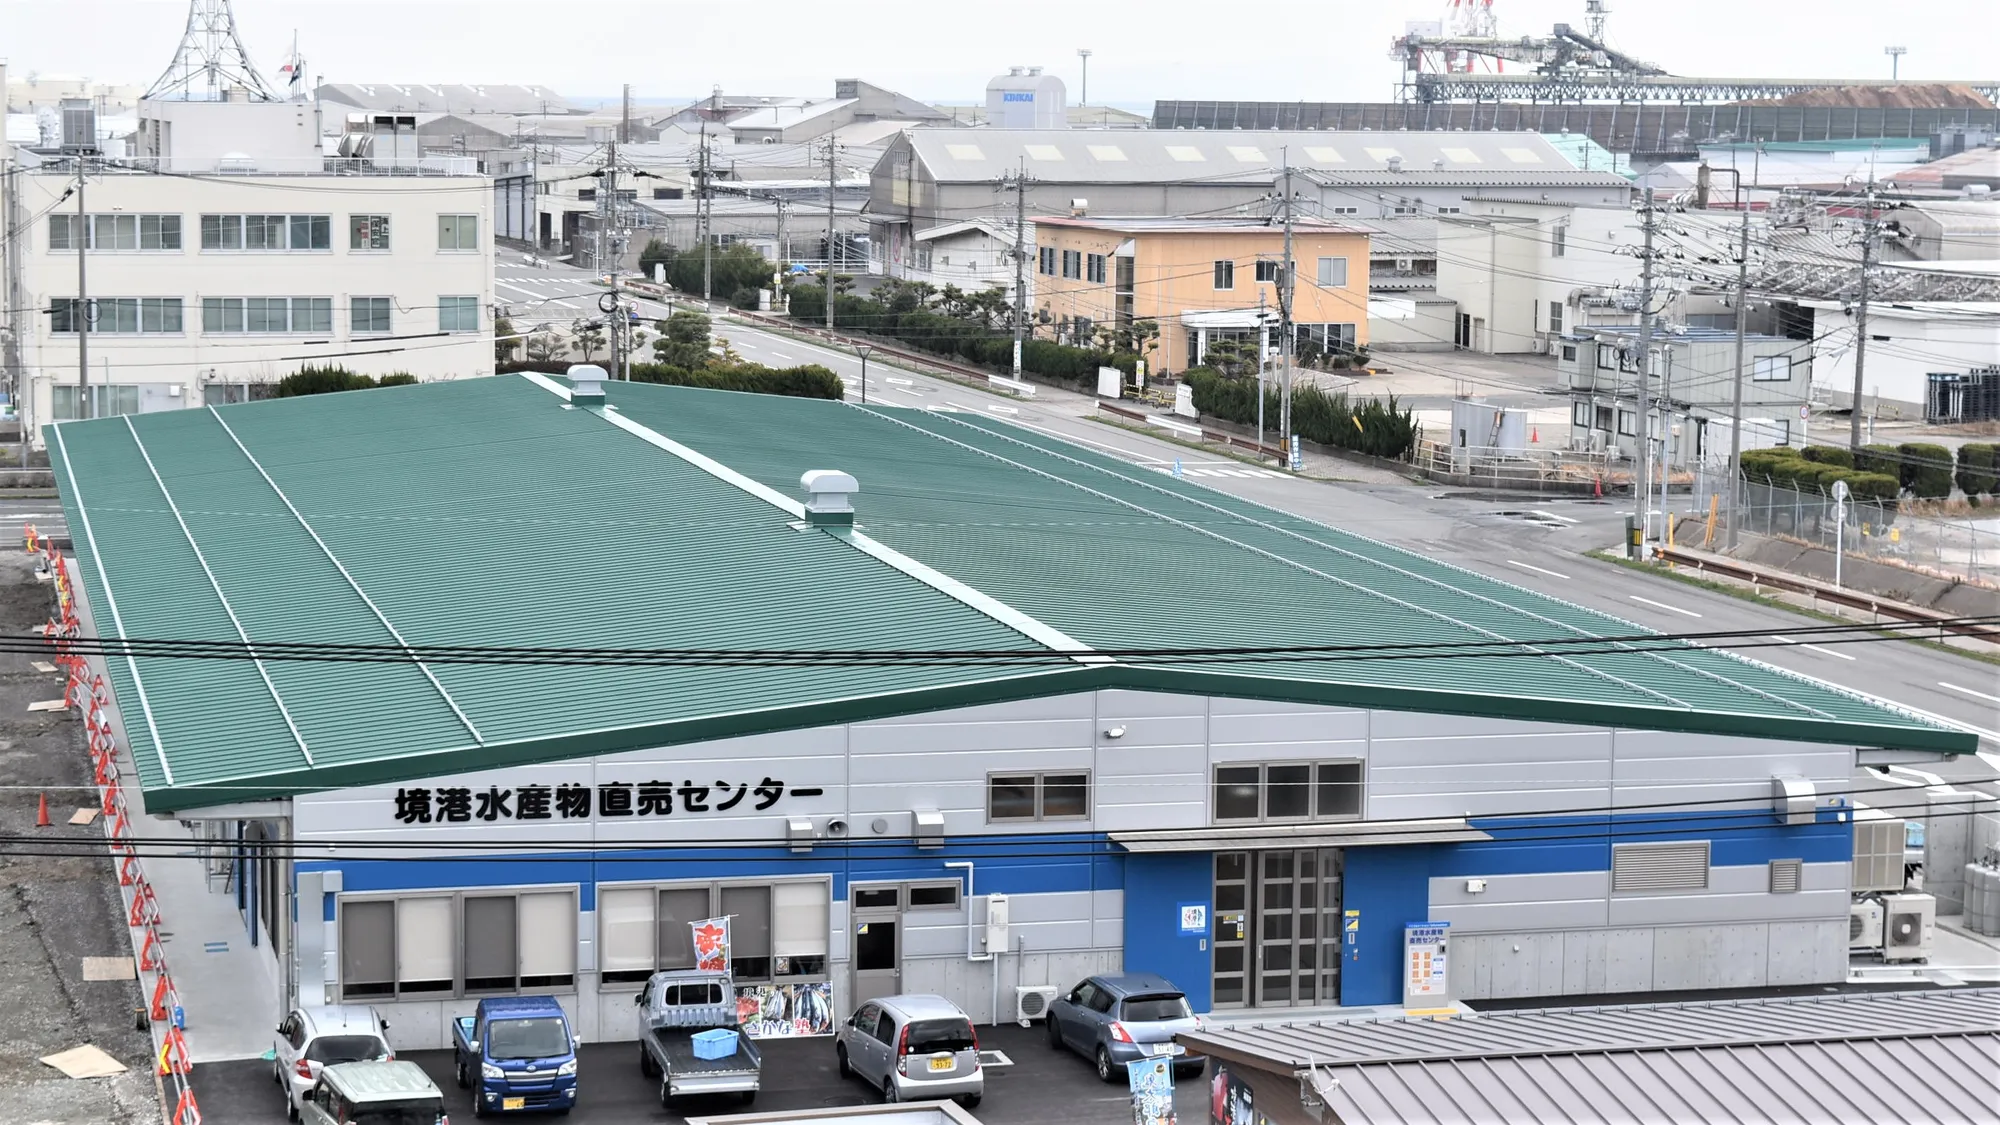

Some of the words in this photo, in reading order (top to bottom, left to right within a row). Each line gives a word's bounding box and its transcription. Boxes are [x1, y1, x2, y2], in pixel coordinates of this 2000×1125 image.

[1003, 93, 1034, 102] KINKAI
[394, 776, 824, 825] 境港水産物直売センター
